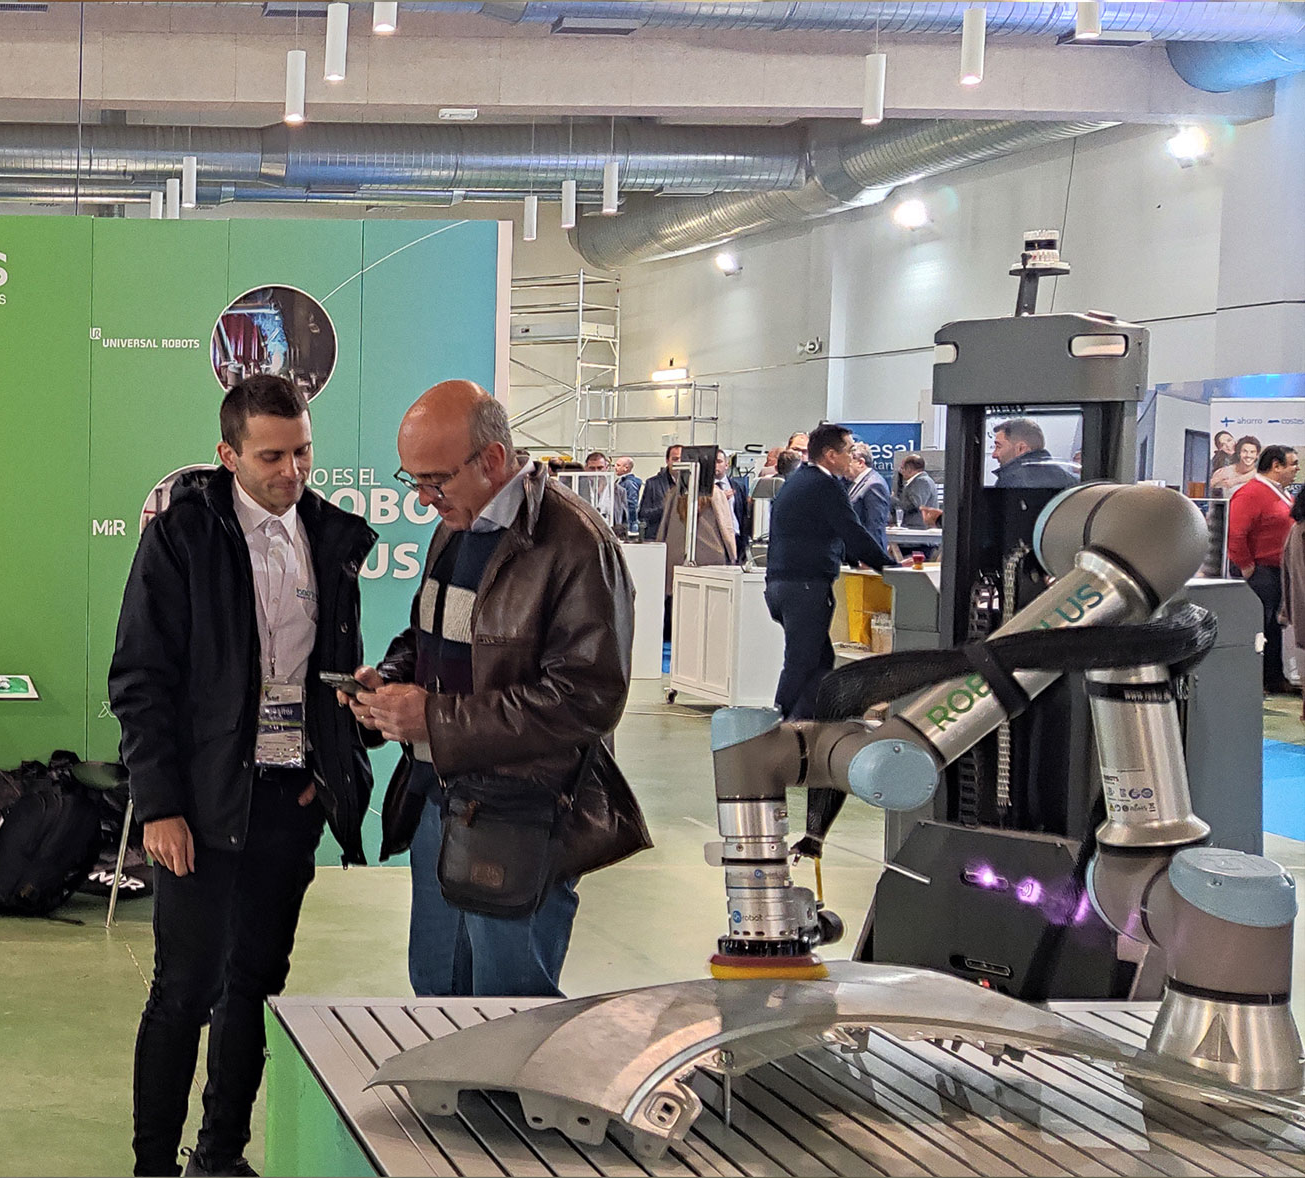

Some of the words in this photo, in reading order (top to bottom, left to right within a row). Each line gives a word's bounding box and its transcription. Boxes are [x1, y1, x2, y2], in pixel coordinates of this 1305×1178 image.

[102, 338, 159, 348] UNIVERSAL
[161, 338, 201, 349] ROBOTS
[332, 468, 354, 486] ES
[359, 468, 382, 486] EL
[359, 542, 421, 580] US
